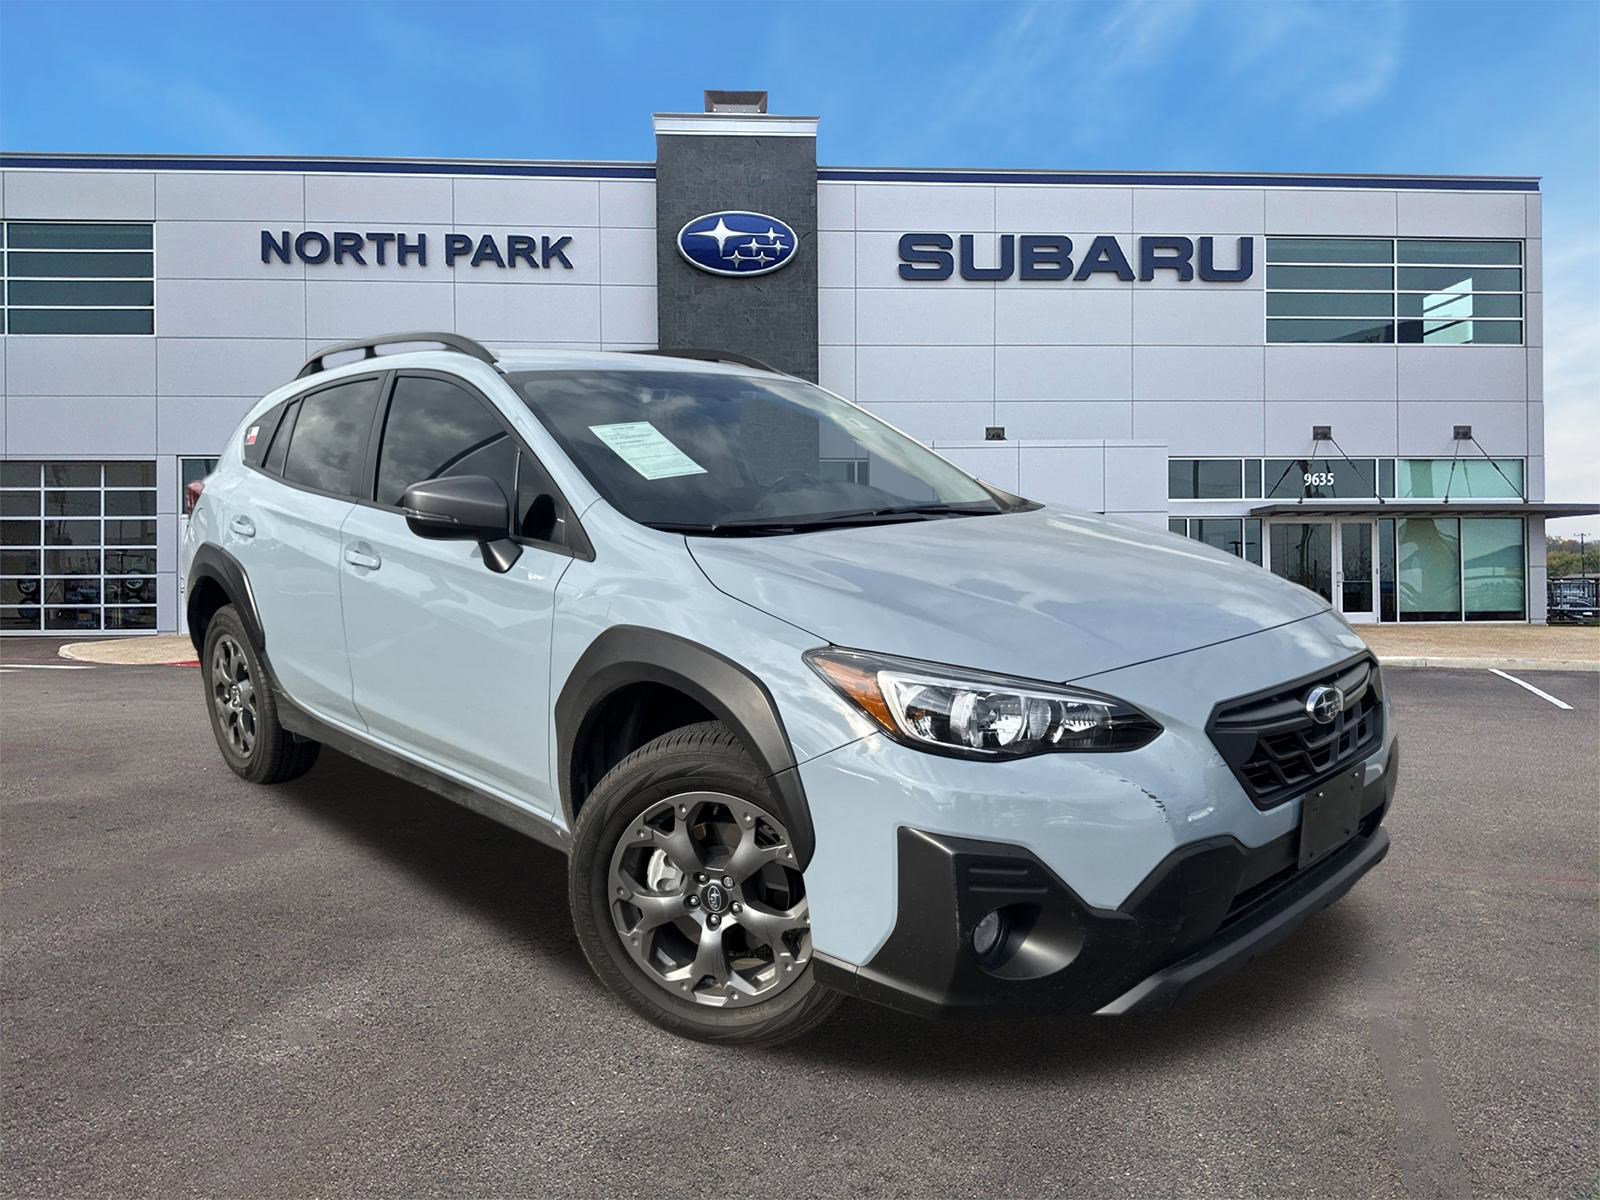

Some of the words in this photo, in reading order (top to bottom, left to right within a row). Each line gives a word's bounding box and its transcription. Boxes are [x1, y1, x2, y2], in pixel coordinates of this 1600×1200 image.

[260, 230, 427, 266] NORTH
[444, 233, 574, 269] PARK
[898, 233, 1254, 282] SUBARU
[1303, 472, 1335, 486] 9635
